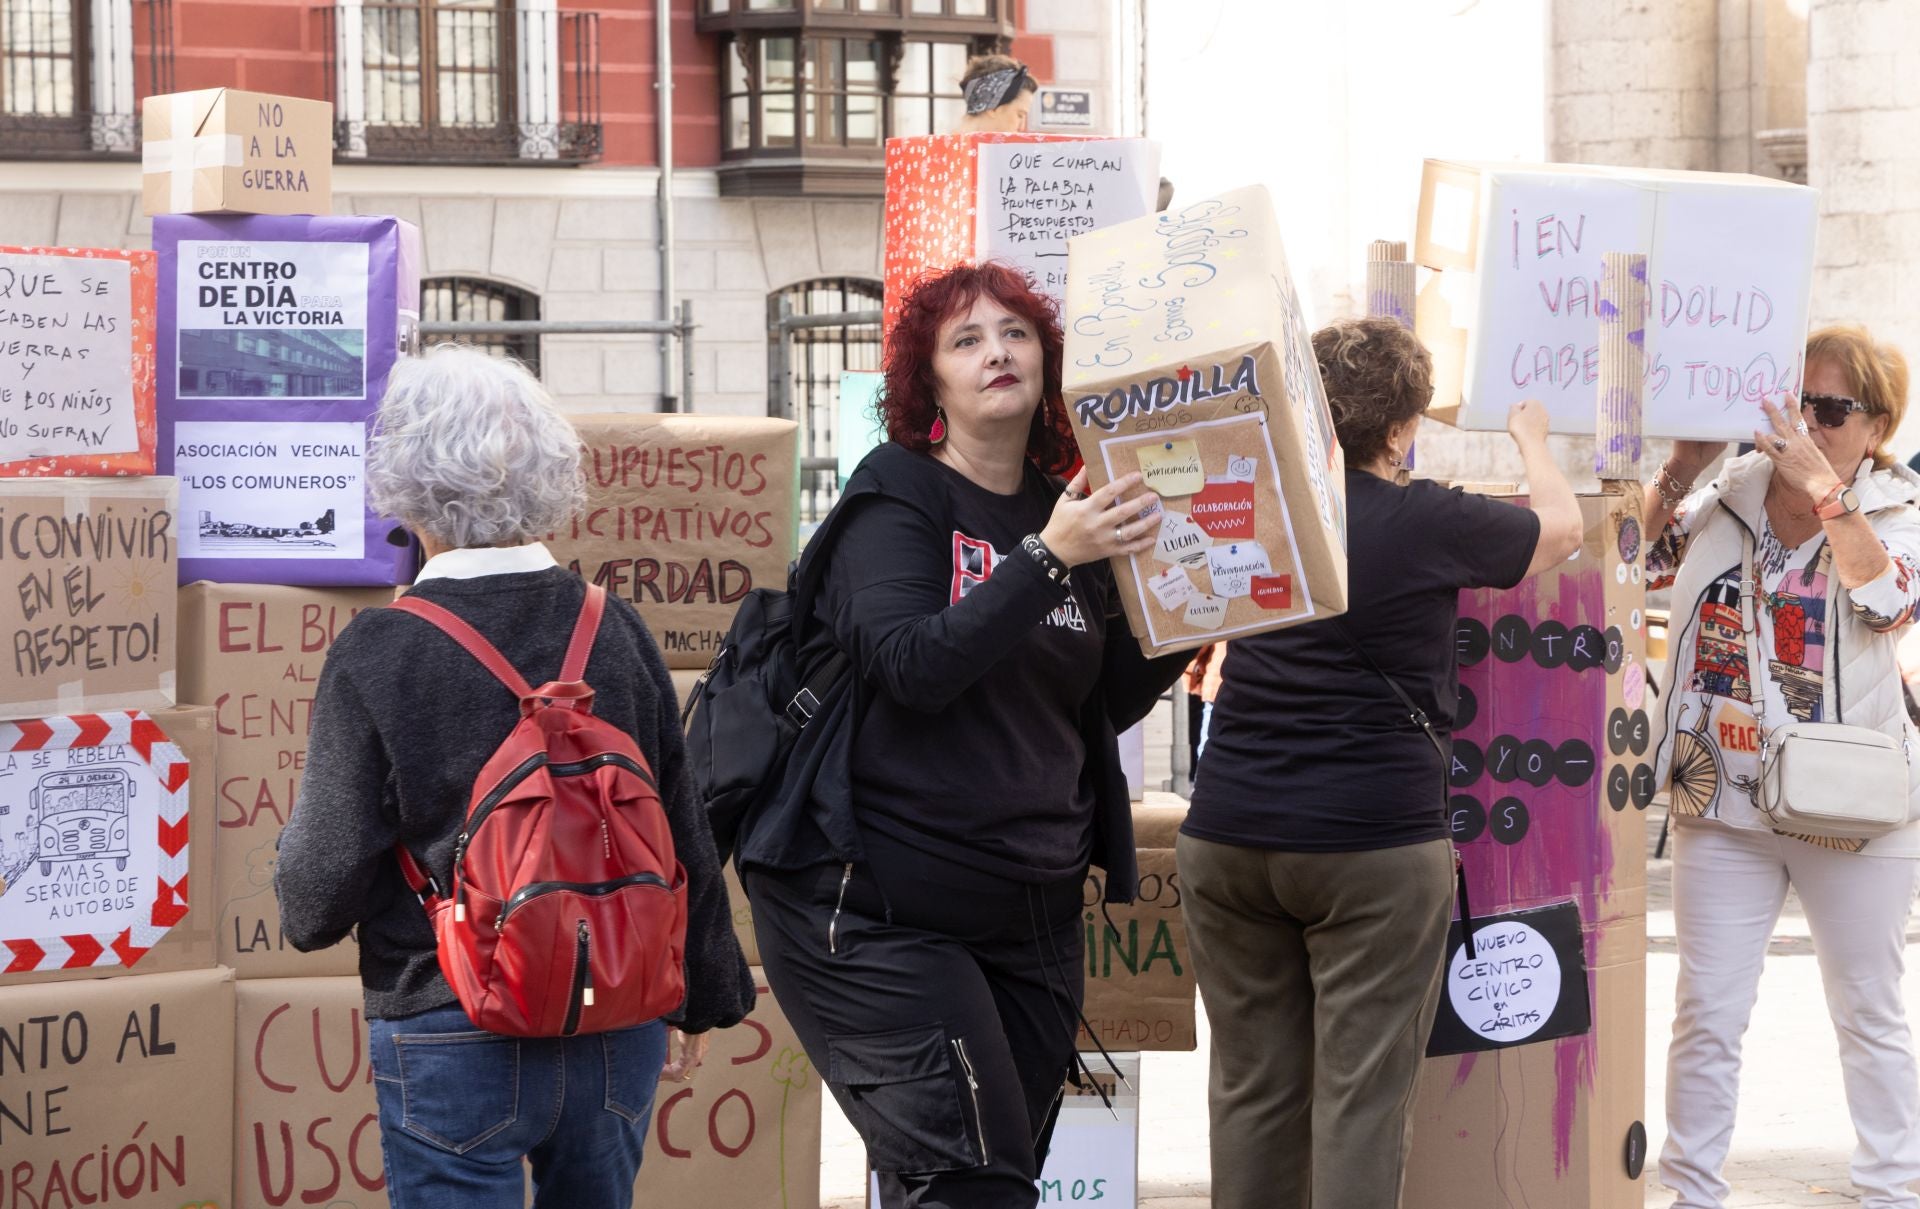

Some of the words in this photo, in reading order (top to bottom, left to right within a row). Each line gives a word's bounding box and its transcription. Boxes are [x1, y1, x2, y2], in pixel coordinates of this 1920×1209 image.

[259, 103, 283, 128] NO
[250, 136, 261, 158] A
[275, 136, 297, 158] LA
[1009, 153, 1042, 170] QUE
[242, 170, 309, 193] GUERRA
[1000, 176, 1017, 196] LA
[1024, 178, 1095, 196] PALABRA
[1001, 196, 1077, 212] PROMETIDA
[1086, 199, 1093, 210] A
[998, 213, 1095, 231] PRESUPUESTOS
[1009, 228, 1088, 243] PARTICIP
[197, 246, 227, 258] POR
[230, 246, 251, 258] UN
[198, 261, 297, 280] CENTRO
[80, 277, 109, 295] SE
[199, 285, 238, 308] DE
[245, 280, 297, 308] DÍA
[301, 296, 342, 308] PARA
[83, 311, 117, 333] LAS
[223, 311, 248, 325] LA
[253, 311, 344, 325] VICTORIA
[21, 362, 36, 380] Y
[1073, 354, 1261, 432] RONDILLA
[1135, 409, 1193, 432] SOMOS
[26, 422, 112, 447] SUFRAN
[176, 442, 277, 458] ASOCIACIÓN
[291, 444, 360, 458] VECINAL
[578, 444, 767, 497] UPUESTOS
[1192, 498, 1253, 514] COLABORACIÓN
[1163, 532, 1200, 553] LUCHA
[18, 568, 54, 622] EN
[1189, 605, 1220, 616] CULTURA
[218, 601, 284, 653] EL
[14, 612, 159, 677] RESPETO!
[282, 663, 317, 682] AL
[1719, 721, 1763, 753] PEAC
[32, 751, 51, 766] SE
[67, 745, 126, 764] REBELA
[278, 750, 306, 770] DE
[57, 862, 104, 882] MAS
[25, 880, 110, 903] SERVICIO
[116, 877, 138, 893] DE
[49, 896, 135, 920] AUTOBUS
[235, 915, 271, 953] LA
[1476, 931, 1527, 952] NUEVO
[1458, 953, 1544, 981] CENTRO
[1493, 1001, 1508, 1011] en
[116, 1003, 176, 1063] AL
[0, 1121, 186, 1209] RACIÓN
